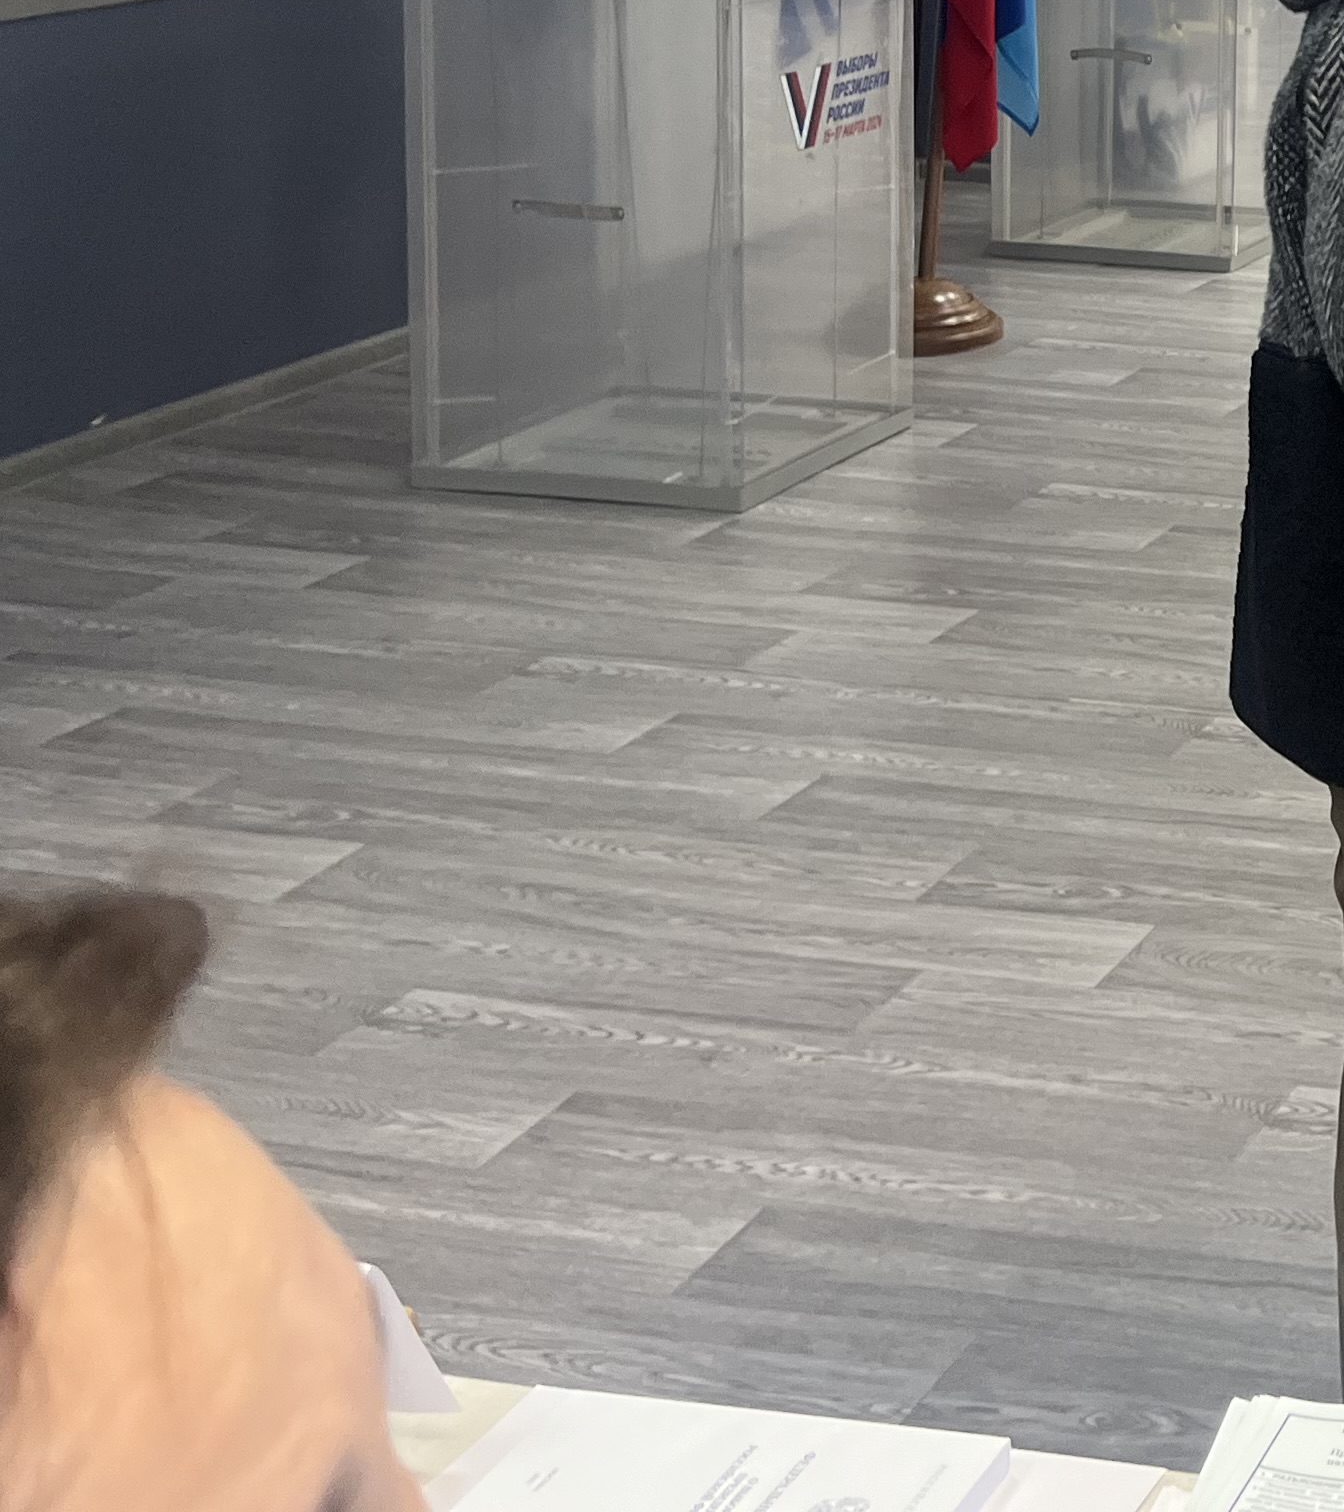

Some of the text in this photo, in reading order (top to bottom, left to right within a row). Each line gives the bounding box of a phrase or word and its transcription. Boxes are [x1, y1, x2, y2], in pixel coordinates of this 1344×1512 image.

[836, 51, 879, 78] ВЫБОРЫ
[831, 70, 890, 101] ПРЕЗИДЕНТА
[826, 97, 866, 124] РОССИИ
